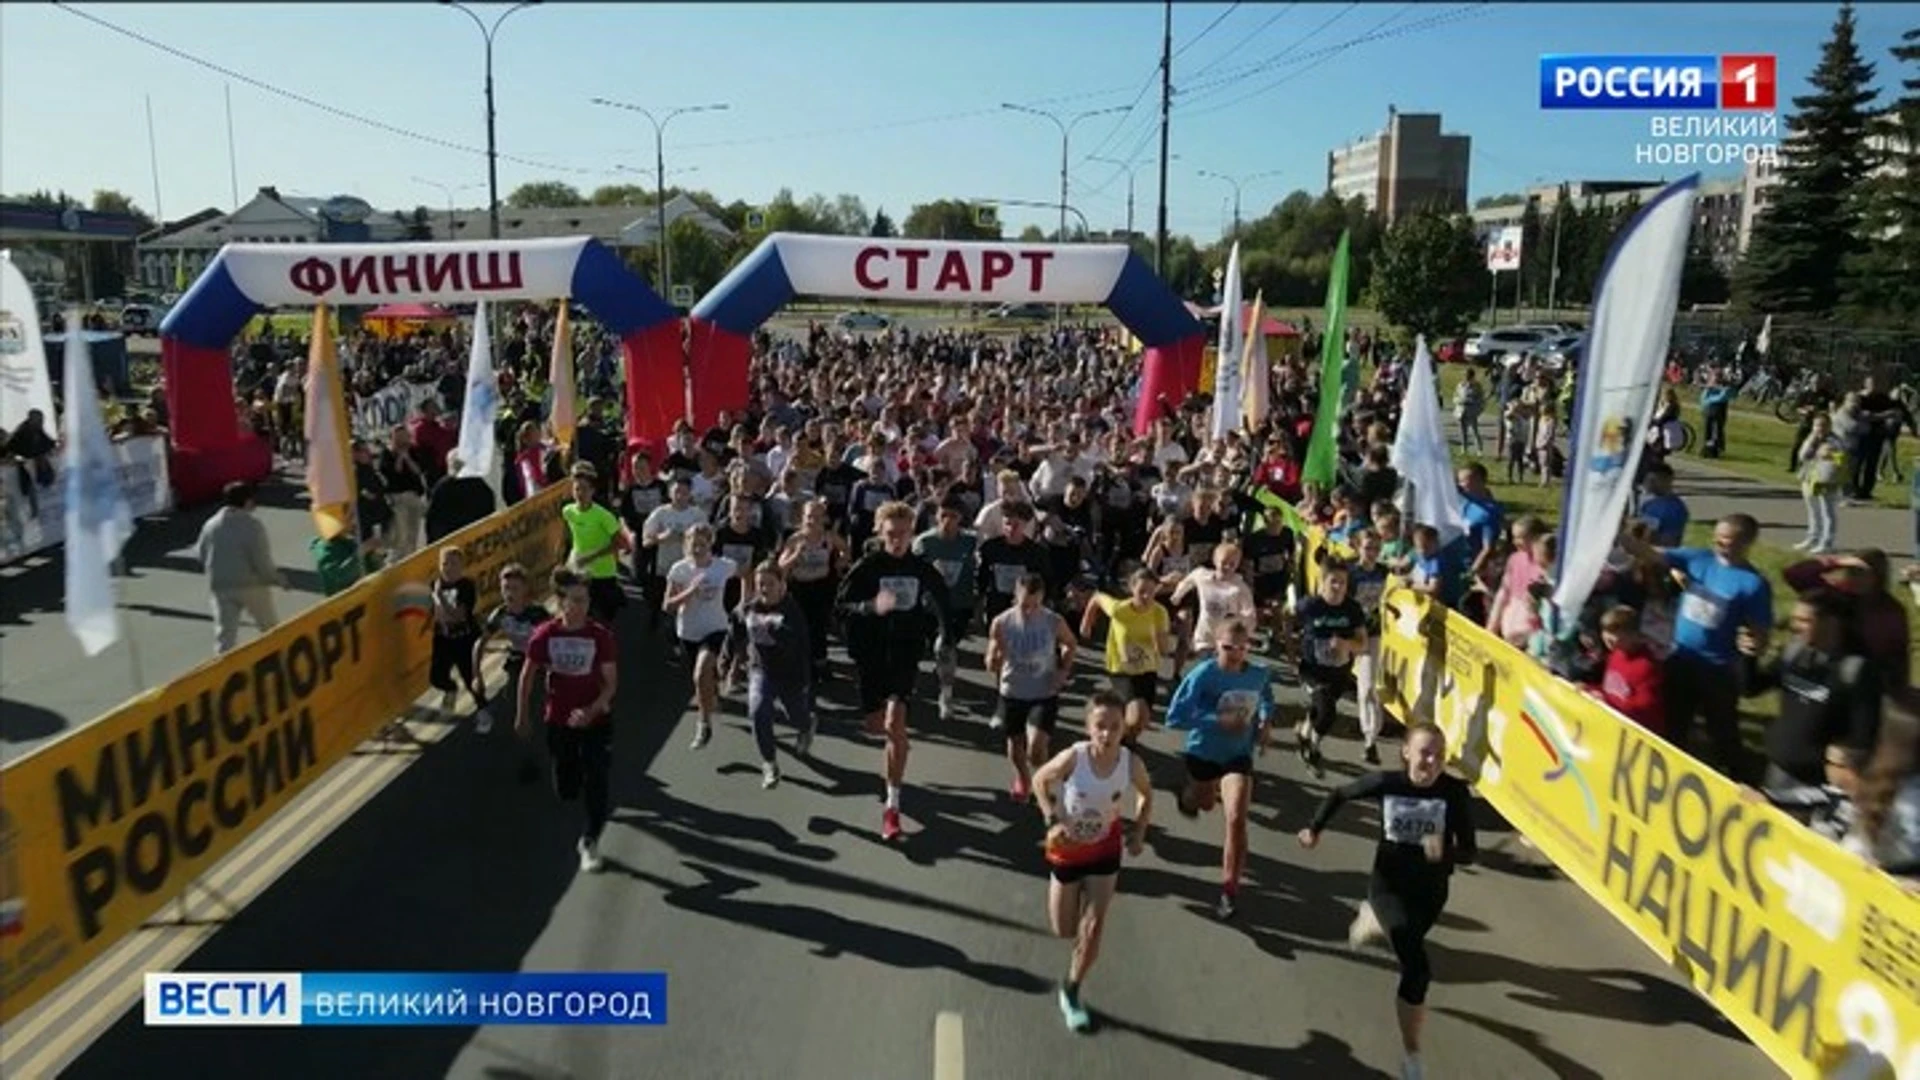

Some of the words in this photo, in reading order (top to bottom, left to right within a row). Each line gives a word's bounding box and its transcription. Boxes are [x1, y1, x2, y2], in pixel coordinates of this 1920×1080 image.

[290, 251, 523, 296] ФИНИШ
[854, 247, 1055, 291] СТАРТ
[55, 605, 366, 850] МИНСПОРТ
[68, 707, 317, 940] РОССИИ
[1611, 728, 1774, 910] КРОСС
[1603, 813, 1821, 1060] НАЦИИ
